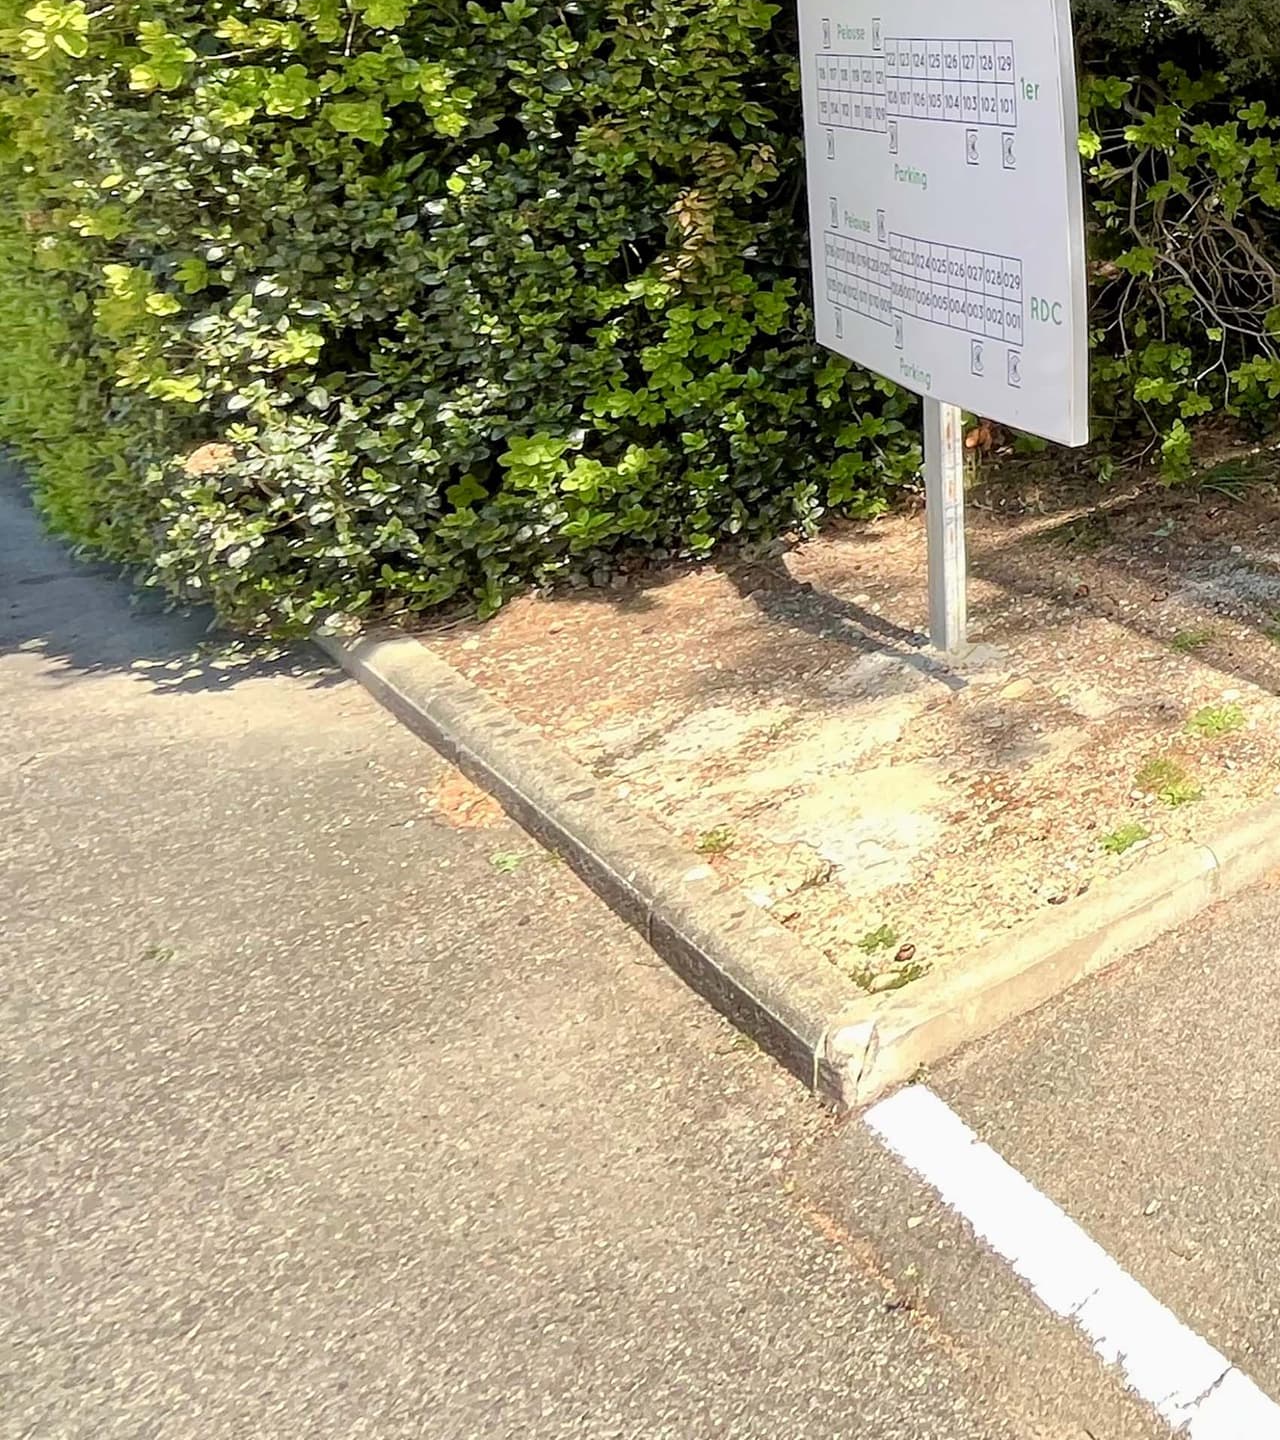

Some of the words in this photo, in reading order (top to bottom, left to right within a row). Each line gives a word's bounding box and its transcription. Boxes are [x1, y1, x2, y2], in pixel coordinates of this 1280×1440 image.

[912, 53, 925, 68] 124
[928, 54, 940, 68] 125
[944, 54, 958, 69] 126
[961, 55, 975, 70] 127
[980, 56, 993, 71] 128
[997, 56, 1012, 71] 129
[913, 93, 925, 107] 106
[928, 94, 941, 108] 105
[944, 95, 960, 109] 104
[963, 96, 977, 111] 103
[981, 97, 996, 113] 102
[1000, 98, 1013, 113] 101
[1020, 77, 1040, 101] 1er
[894, 163, 928, 190] Parking
[916, 254, 930, 269] 024
[932, 257, 946, 274] 025
[950, 261, 965, 278] 026
[967, 265, 982, 282] 027
[985, 269, 1001, 286] 028
[1004, 272, 1020, 290] 029
[917, 290, 931, 306] 006
[933, 294, 947, 311] 005
[950, 298, 966, 314] 004
[967, 304, 984, 320] 003
[986, 307, 1003, 325] 002
[1005, 311, 1020, 329] 001
[1031, 296, 1062, 325] RDC
[900, 357, 931, 390] Parking
